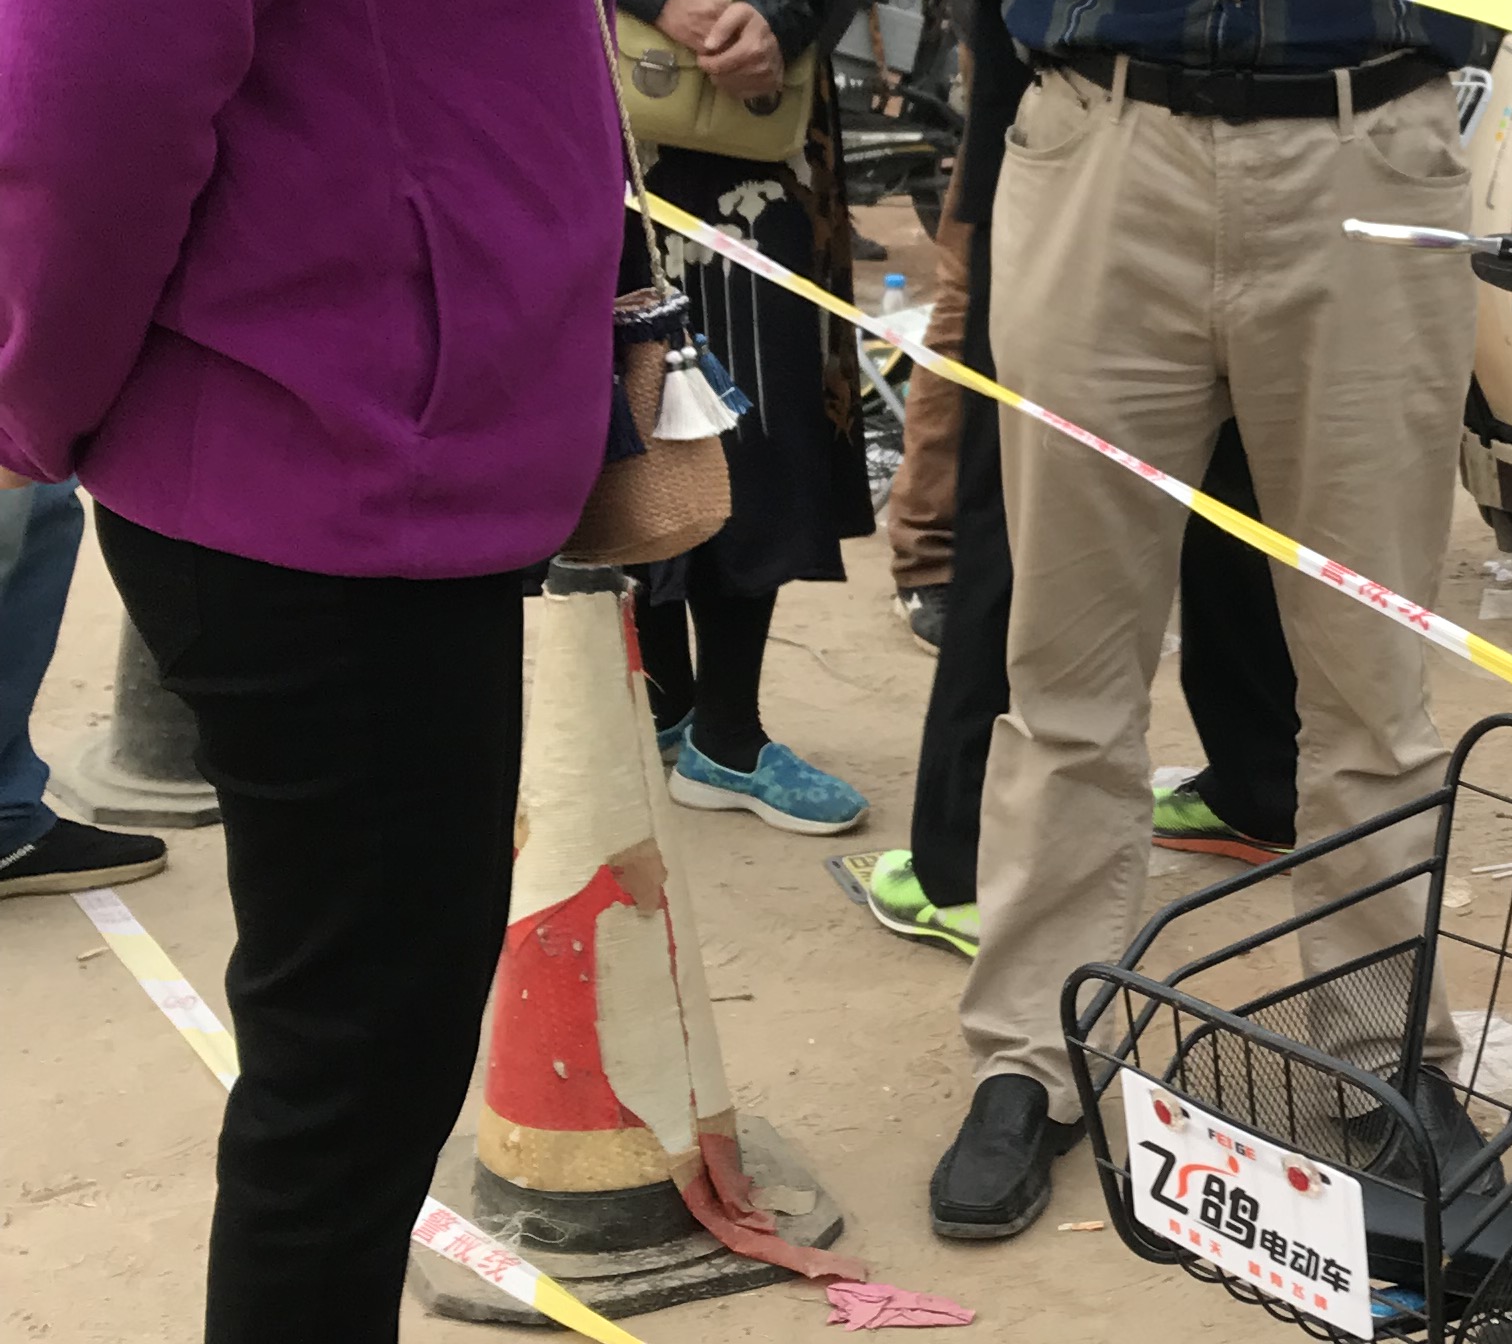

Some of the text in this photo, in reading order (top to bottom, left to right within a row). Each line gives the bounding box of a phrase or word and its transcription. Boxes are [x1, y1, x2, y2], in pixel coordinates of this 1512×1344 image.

[412, 1208, 522, 1283] 警戒线
[1259, 1229, 1353, 1293] 电动车
